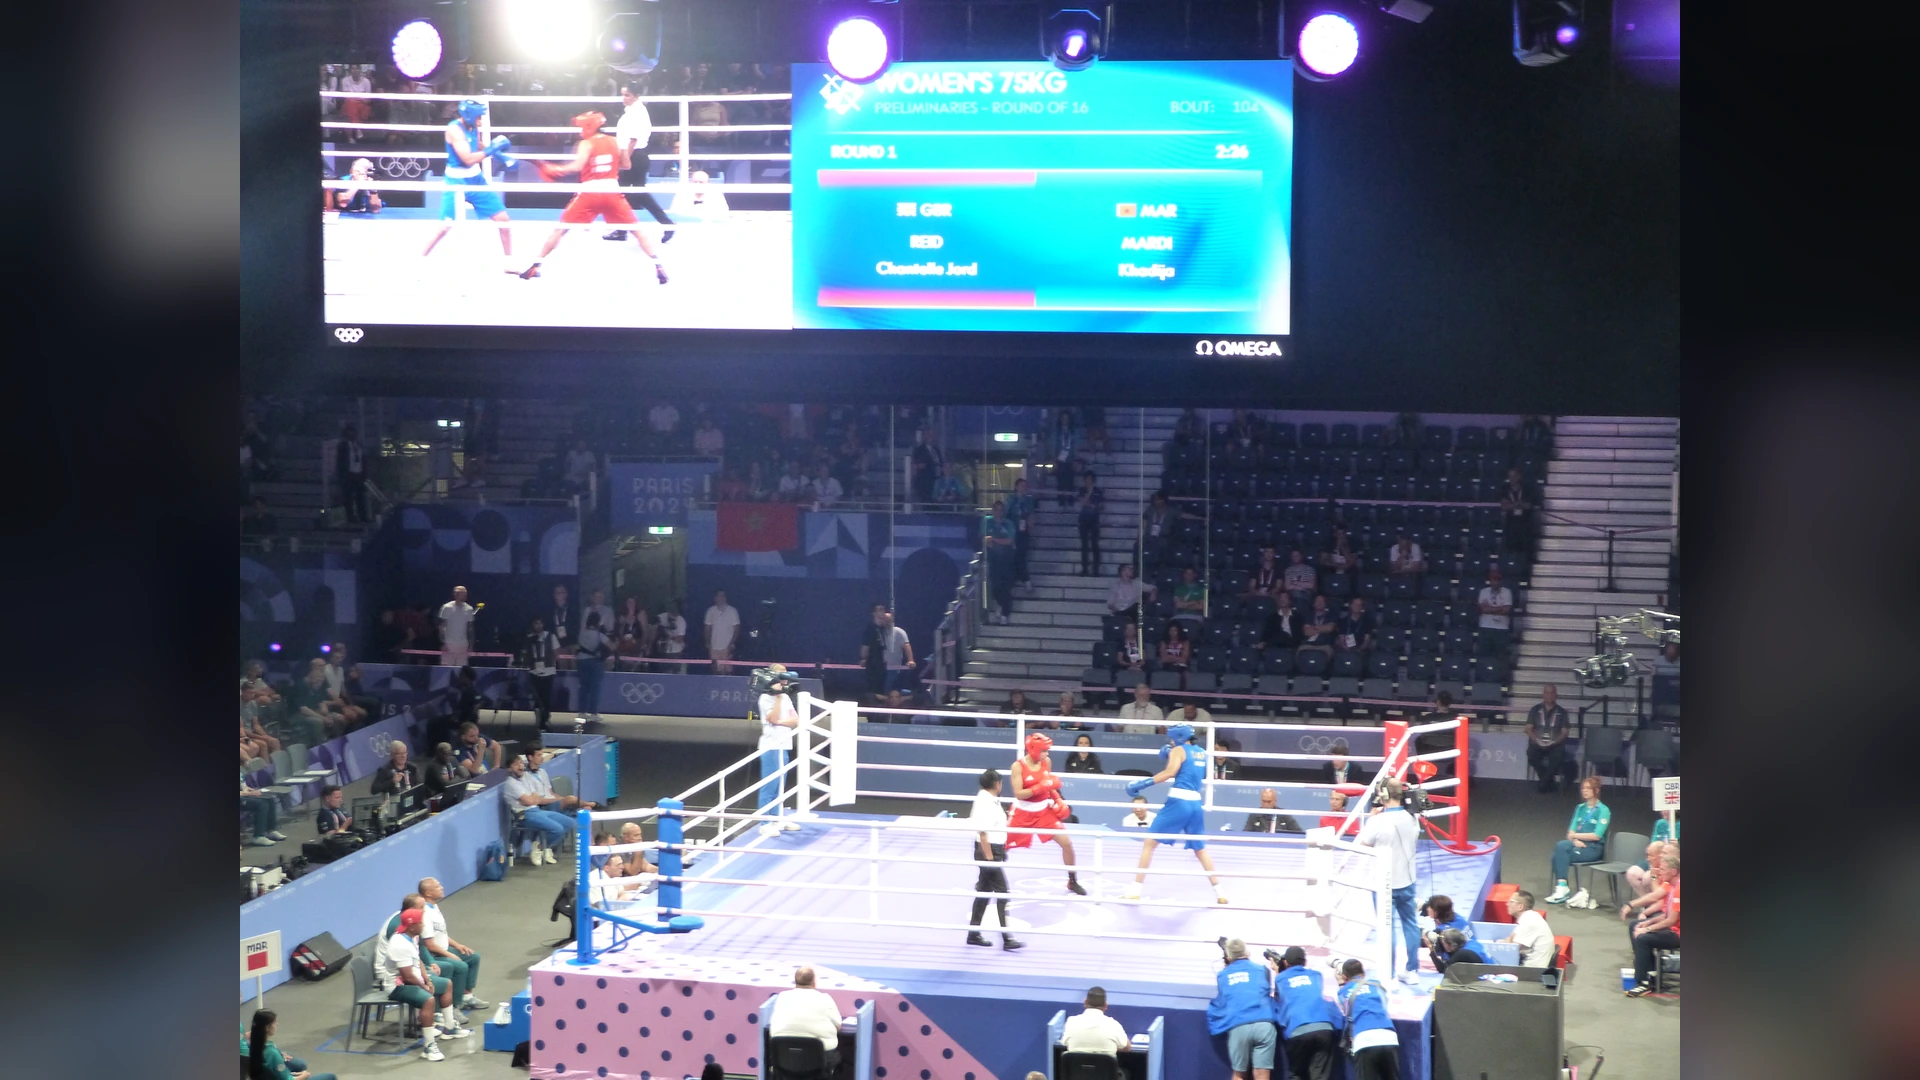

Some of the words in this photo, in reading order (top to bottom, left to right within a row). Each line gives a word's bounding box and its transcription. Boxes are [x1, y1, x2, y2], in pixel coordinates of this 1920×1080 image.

[875, 71, 994, 94] WOMEN'S
[1000, 71, 1068, 94] 75KG
[874, 101, 978, 115] PRELIMINARIES
[992, 101, 1044, 115] ROUND
[1047, 101, 1069, 114] OF
[1072, 101, 1089, 114] 16
[1169, 100, 1215, 114] BOUT:
[1233, 100, 1260, 113] 104
[830, 145, 885, 159] ROUND
[887, 145, 898, 159] 1
[1215, 144, 1250, 159] 2:26
[919, 203, 952, 217] GBR
[1140, 204, 1178, 218] MAR
[909, 235, 944, 249] REID
[1121, 236, 1173, 250] MARDI
[876, 261, 944, 276] Chantelle
[946, 262, 978, 276] Jord
[1118, 263, 1175, 281] Khadija
[1215, 341, 1282, 356] OMEGA
[633, 478, 694, 494] PARIS
[1468, 749, 1517, 763] 2024
[247, 941, 268, 954] MAR
